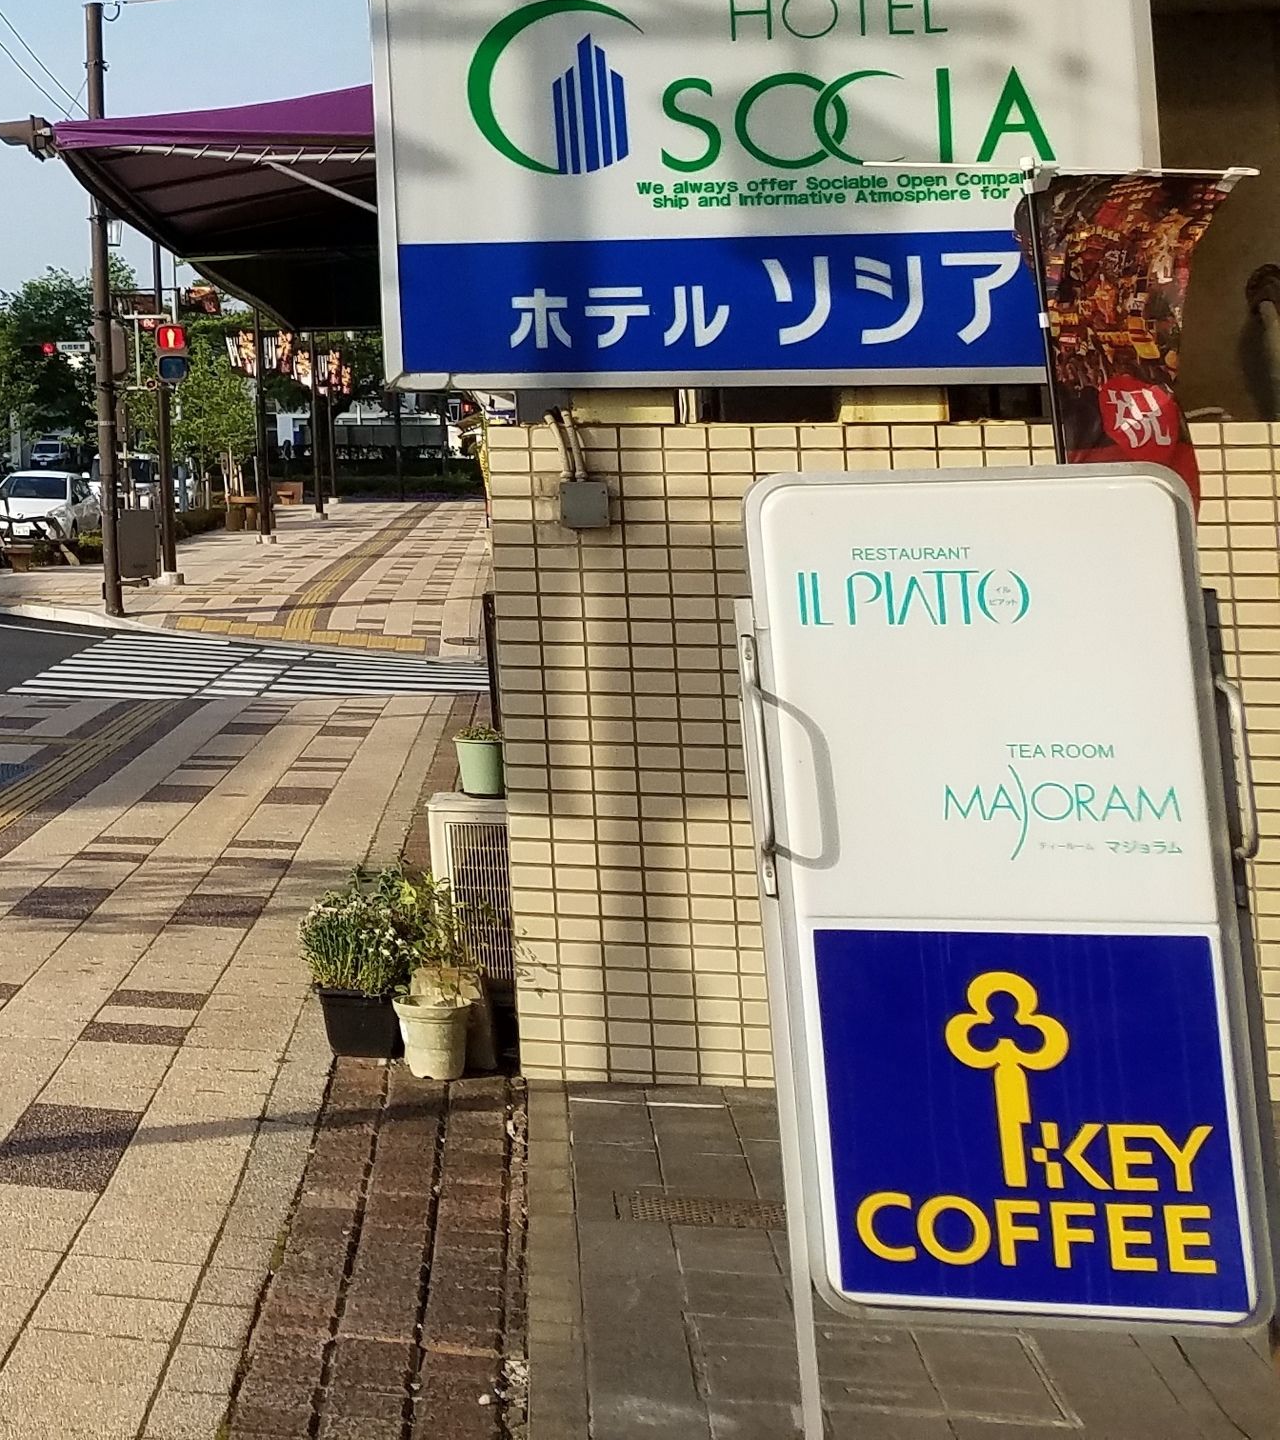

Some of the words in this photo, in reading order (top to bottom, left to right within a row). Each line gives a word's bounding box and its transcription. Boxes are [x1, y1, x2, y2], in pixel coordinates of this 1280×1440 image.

[660, 65, 1058, 173] SOCIA
[636, 181, 665, 195] We
[673, 178, 739, 195] always
[746, 177, 798, 192] offer
[806, 174, 888, 191] Sociable
[896, 172, 948, 190] Open
[652, 193, 690, 210] ship
[697, 192, 732, 208] and
[739, 189, 846, 207] Informative
[854, 186, 971, 204] Atmosphere
[981, 184, 1011, 200] for
[509, 284, 731, 349] ホテル
[760, 251, 1022, 346] ソシア
[1105, 387, 1173, 449] 祝
[851, 546, 971, 562] RESTAURANT
[797, 571, 835, 627] IL
[846, 568, 1031, 627] PIATTO
[1006, 743, 1047, 758] TEA
[1051, 743, 1115, 758] ROOM
[944, 763, 1182, 861] MAJORAM
[1105, 840, 1183, 855] マジョラム
[1031, 1121, 1215, 1193] KEY
[855, 1190, 1219, 1275] COFFEE
